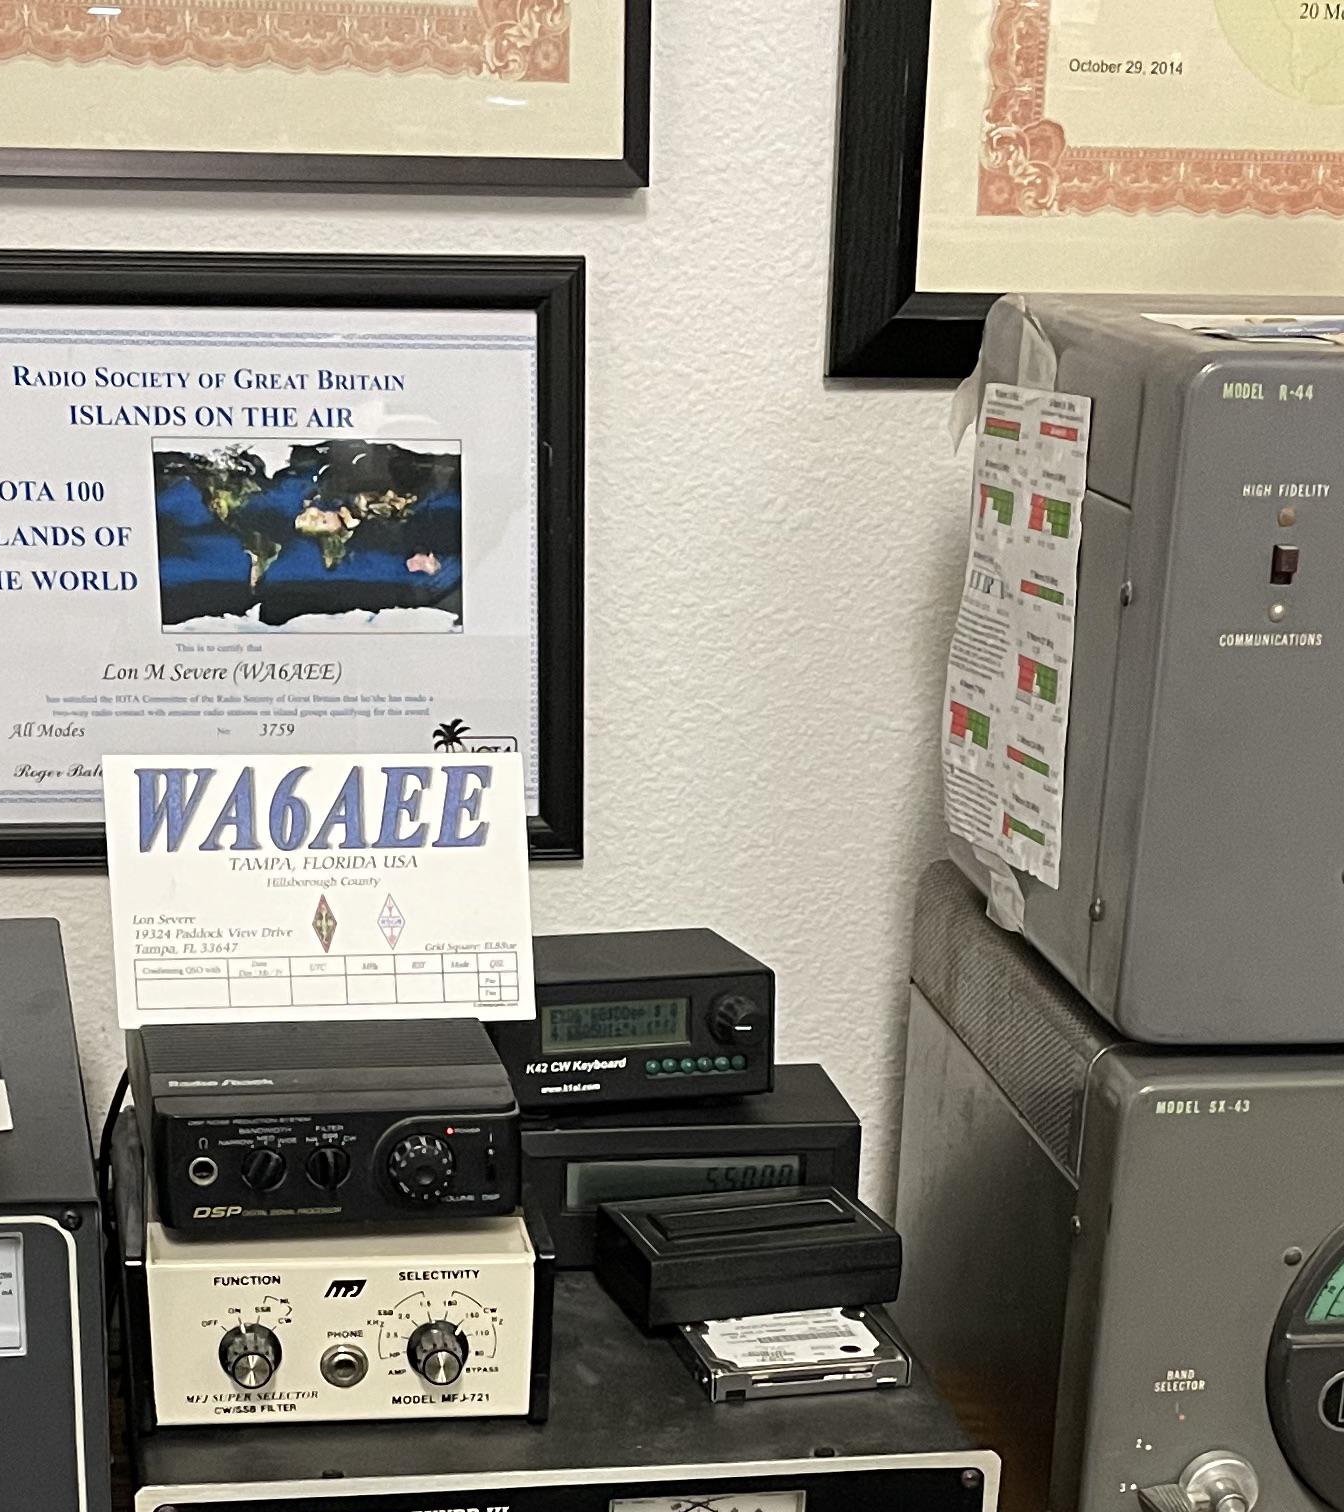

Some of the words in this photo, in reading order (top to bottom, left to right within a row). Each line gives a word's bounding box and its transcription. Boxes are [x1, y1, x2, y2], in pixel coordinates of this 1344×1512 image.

[1300, 3, 1318, 20] 20
[1069, 58, 1123, 75] October
[1127, 60, 1146, 77] 29,
[1150, 60, 1183, 75] 2014
[13, 365, 87, 388] RADIO
[94, 367, 192, 391] SOCIETY
[197, 372, 227, 390] OF
[233, 367, 308, 391] GREAT
[317, 369, 405, 392] BRITAIN
[1222, 383, 1264, 399] MODEL
[1279, 384, 1313, 401] R-44
[69, 404, 186, 427] ISLANDS
[194, 406, 235, 428] ON
[241, 406, 298, 429] THE
[306, 406, 354, 429] AIR
[65, 480, 105, 502] 100
[1243, 484, 1271, 497] HIGH
[1278, 484, 1330, 497] FIDELITY
[93, 525, 133, 547] OF
[31, 570, 139, 592] WORLD
[1219, 633, 1323, 647] COMMUNICATIONS
[102, 663, 138, 681] Lon
[142, 663, 166, 681] M
[169, 663, 228, 681] Severe
[233, 662, 343, 685] (WA6AEE)
[8, 722, 32, 739] All
[37, 723, 86, 739] Modes
[258, 722, 295, 737] 3759
[13, 764, 63, 782] Roger
[133, 764, 494, 853] WA6AEE
[228, 857, 298, 872] TAMPA,
[302, 855, 377, 870] FLORIDA
[383, 855, 419, 868] USA
[266, 877, 338, 889] Hillsborough
[340, 876, 382, 889] County
[133, 915, 156, 925] Lon
[158, 915, 197, 925] Severe
[175, 928, 224, 939] Paddock
[228, 927, 259, 938] View
[261, 927, 293, 938] Drive
[525, 1063, 548, 1075] K42
[550, 1061, 572, 1073] CW
[572, 1057, 627, 1073] Keyboard
[1156, 1100, 1200, 1115] MODEL
[1208, 1099, 1250, 1114] SX-43
[192, 1206, 243, 1219] DSP
[213, 1275, 281, 1287] FUNCTION
[398, 1269, 480, 1281] SELECTIVITY
[327, 1329, 364, 1339] PHONE
[1166, 1369, 1195, 1380] BAND
[1154, 1380, 1206, 1392] SELECTOR
[255, 1390, 319, 1402] SELECTOR
[391, 1394, 437, 1406] MODEL
[441, 1393, 491, 1404] MFJ-721
[260, 1403, 297, 1414] FILTER
